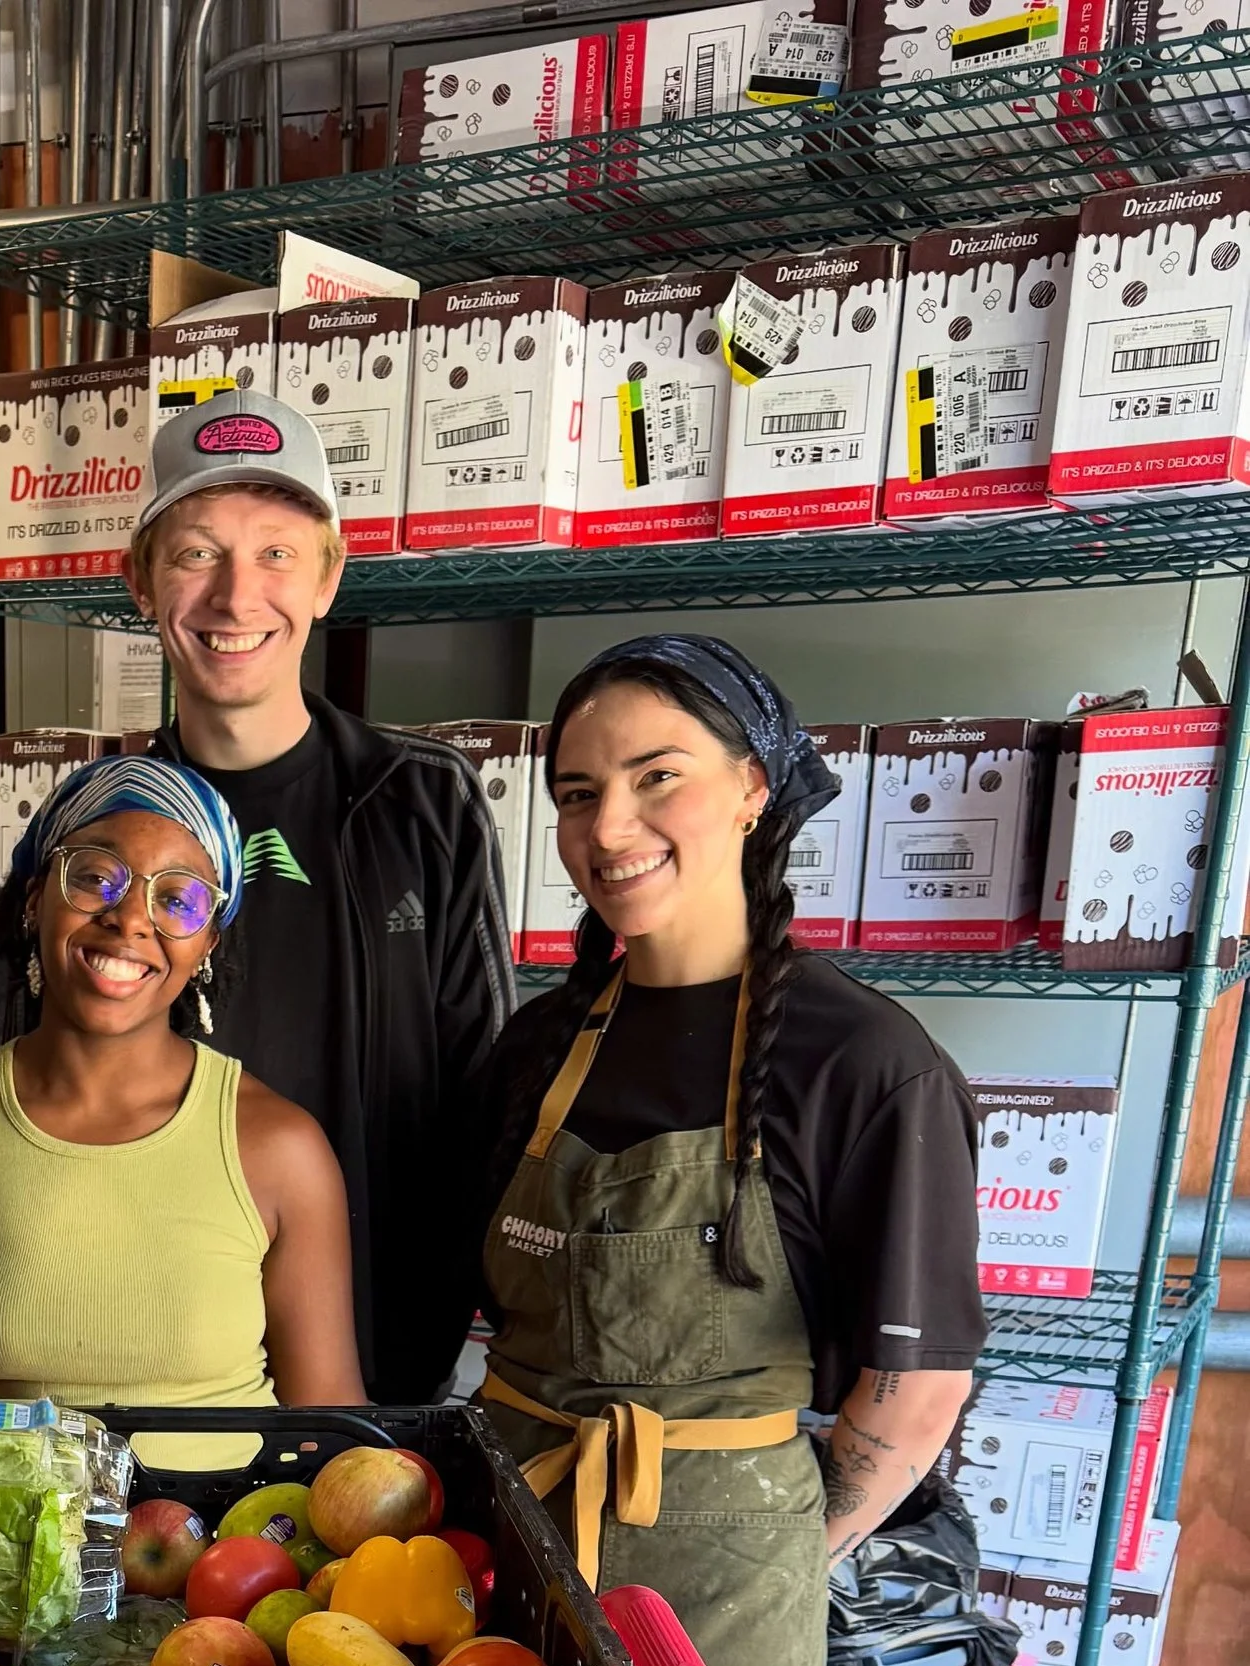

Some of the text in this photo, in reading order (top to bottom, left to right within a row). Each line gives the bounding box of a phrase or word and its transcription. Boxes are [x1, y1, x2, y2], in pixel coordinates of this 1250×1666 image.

[769, 43, 835, 62] 429 014 A
[622, 53, 635, 100] DRIZZLED
[1122, 190, 1224, 217] Drizzilicious
[949, 232, 1039, 256] Drizzilicious
[775, 259, 861, 283] Drizzilicious
[446, 290, 521, 312] Drizzilicious
[623, 284, 703, 306] Drizzilicious
[308, 311, 378, 330] Drizzilicious
[738, 310, 784, 346] 429 014
[175, 324, 240, 344] Drizzilicious
[51, 377, 70, 388] RICE
[71, 373, 100, 386] CAKES
[100, 366, 149, 381] REIMAGINE
[661, 407, 672, 430] 014
[953, 370, 967, 455] 220 006 A
[664, 443, 675, 465] 429
[1061, 453, 1226, 478] IT'S DRIZZLED & IT'S DELICIOUS!
[10, 456, 144, 502] Drizzilicio
[895, 481, 1045, 502] IT'S DRIZZLED & IT'S DELICIOUS!
[731, 510, 748, 521] IT'S
[749, 507, 792, 520] DRIZZLED
[792, 506, 801, 515] &
[802, 504, 819, 515] IT'S
[7, 524, 27, 540] IT'S
[29, 520, 80, 538] DRIZZLED
[83, 519, 92, 533] &
[94, 517, 115, 532] IT'S
[428, 522, 465, 535] DRIZZLED
[603, 521, 643, 534] DRIZZLED
[643, 520, 652, 531] &
[653, 518, 670, 530] IT'S
[908, 729, 986, 745] Drizzilicious
[1095, 725, 1149, 739] DELICIOUS!
[1152, 724, 1170, 736] IT'S
[1172, 723, 1181, 734] &
[13, 740, 65, 755] Drizzilicious
[1095, 769, 1217, 797] izzilicious
[977, 1093, 1055, 1106] REIMAGINED!
[501, 1215, 568, 1250] CHICORY
[705, 1226, 718, 1243] &
[988, 1232, 1069, 1248] DELICIOUS!
[507, 1238, 555, 1259] MARKET
